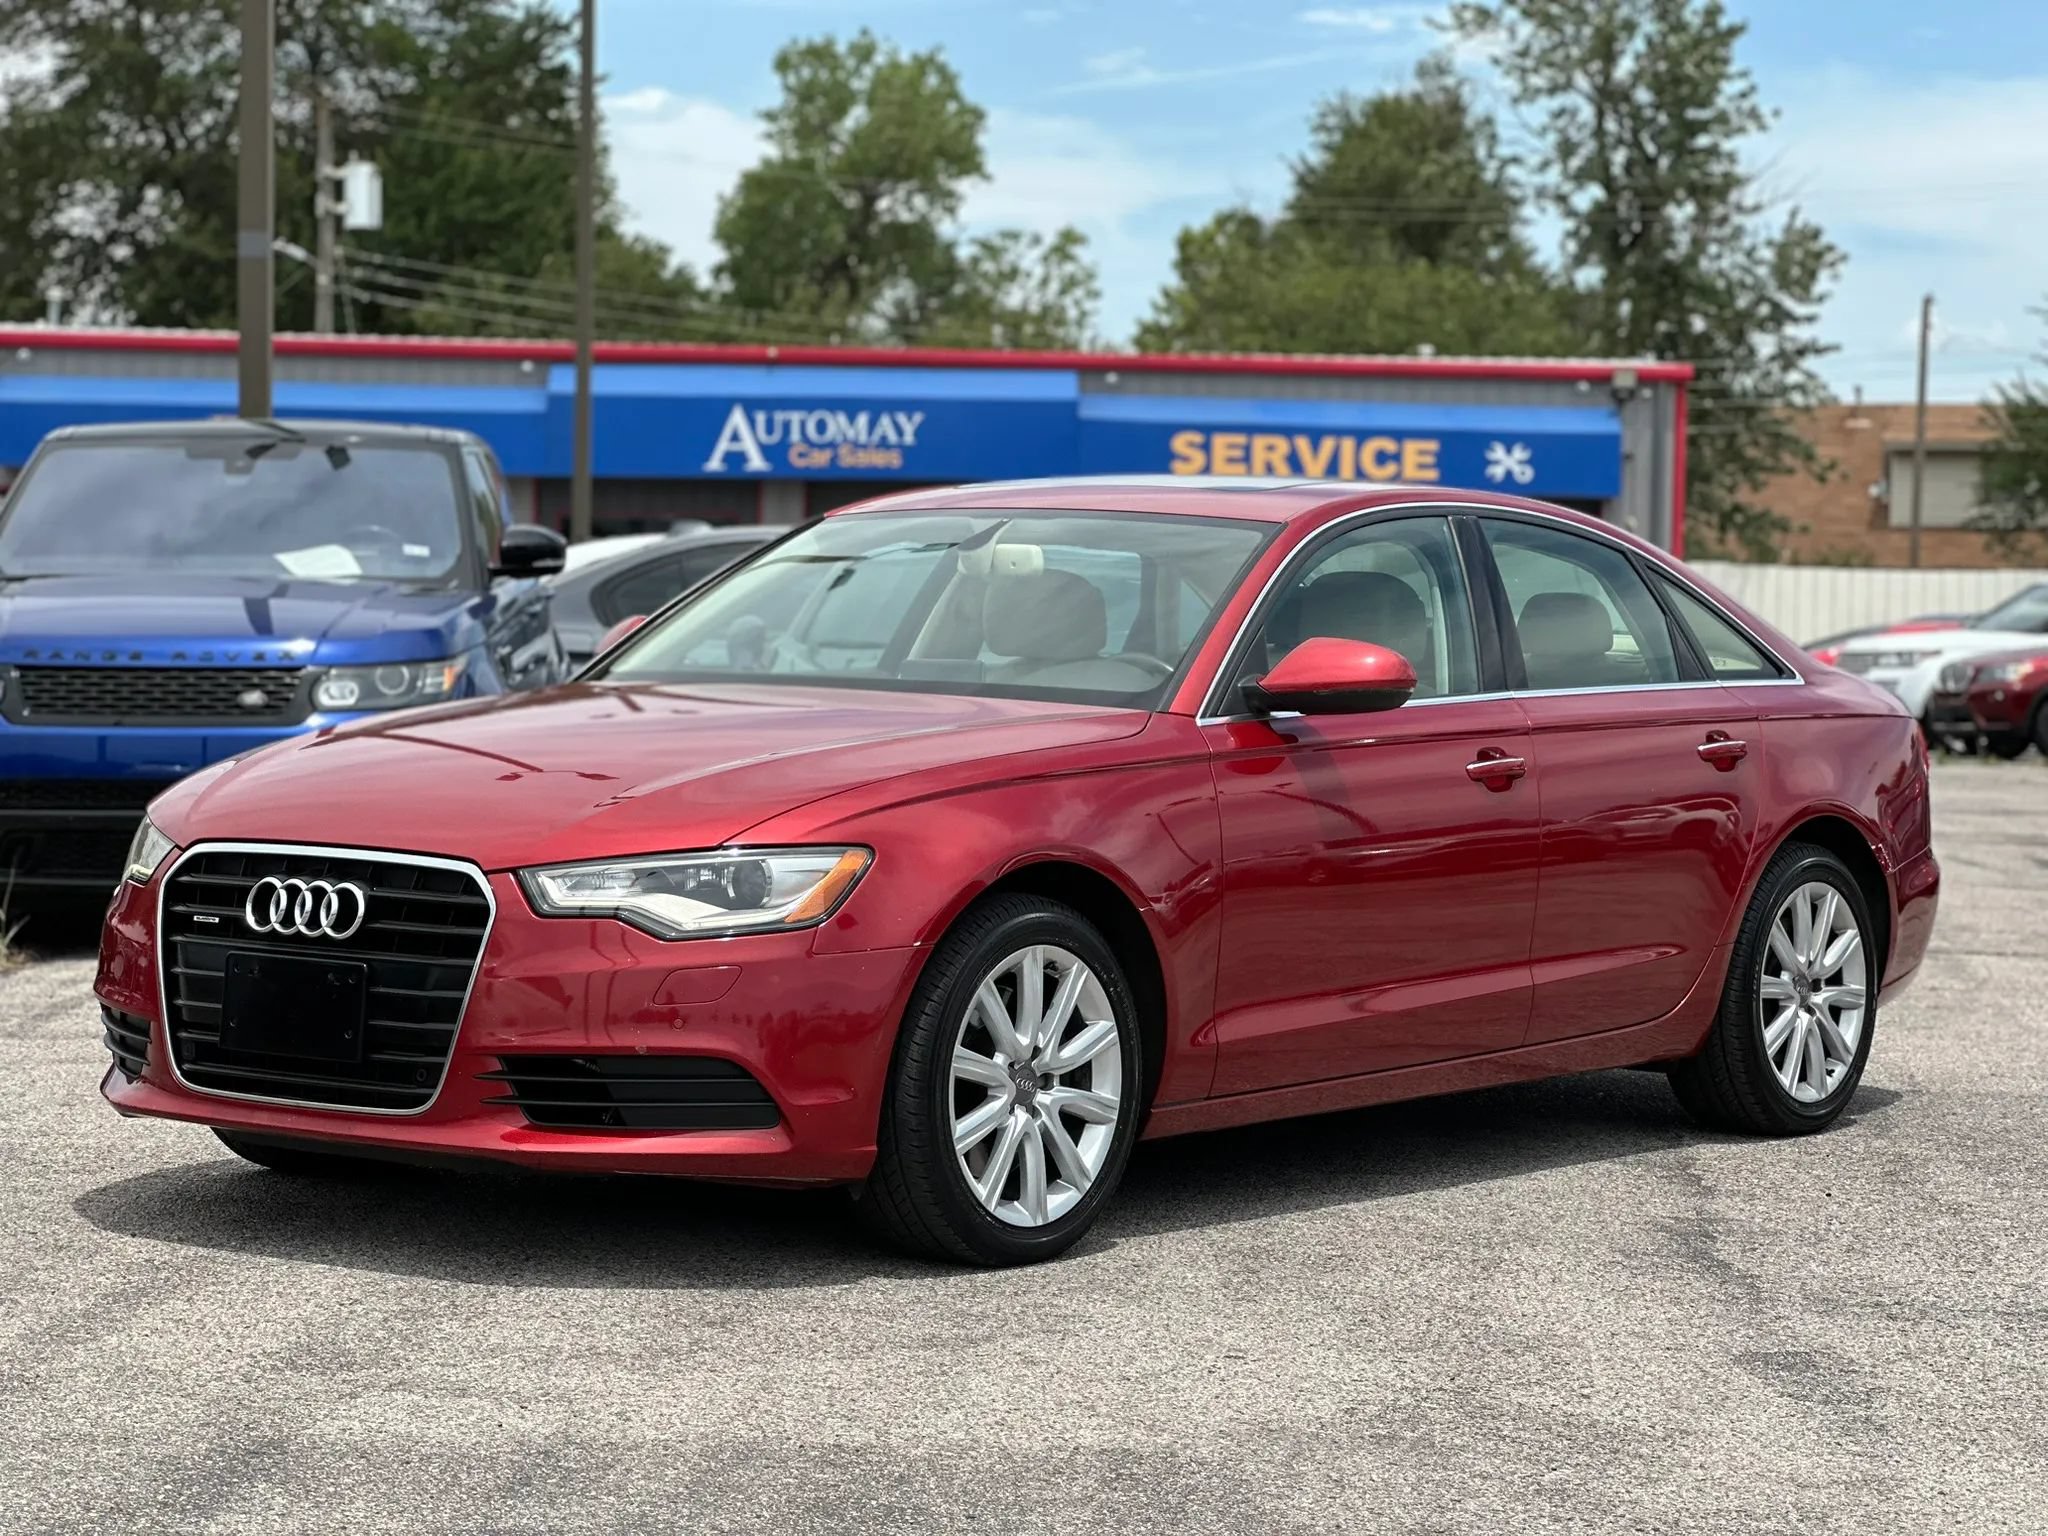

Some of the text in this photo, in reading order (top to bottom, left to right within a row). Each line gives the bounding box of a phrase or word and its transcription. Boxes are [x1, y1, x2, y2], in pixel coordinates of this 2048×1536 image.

[703, 403, 926, 472] AUTOMAY
[788, 443, 902, 469] Car Sales
[1170, 430, 1441, 481] SERVICE
